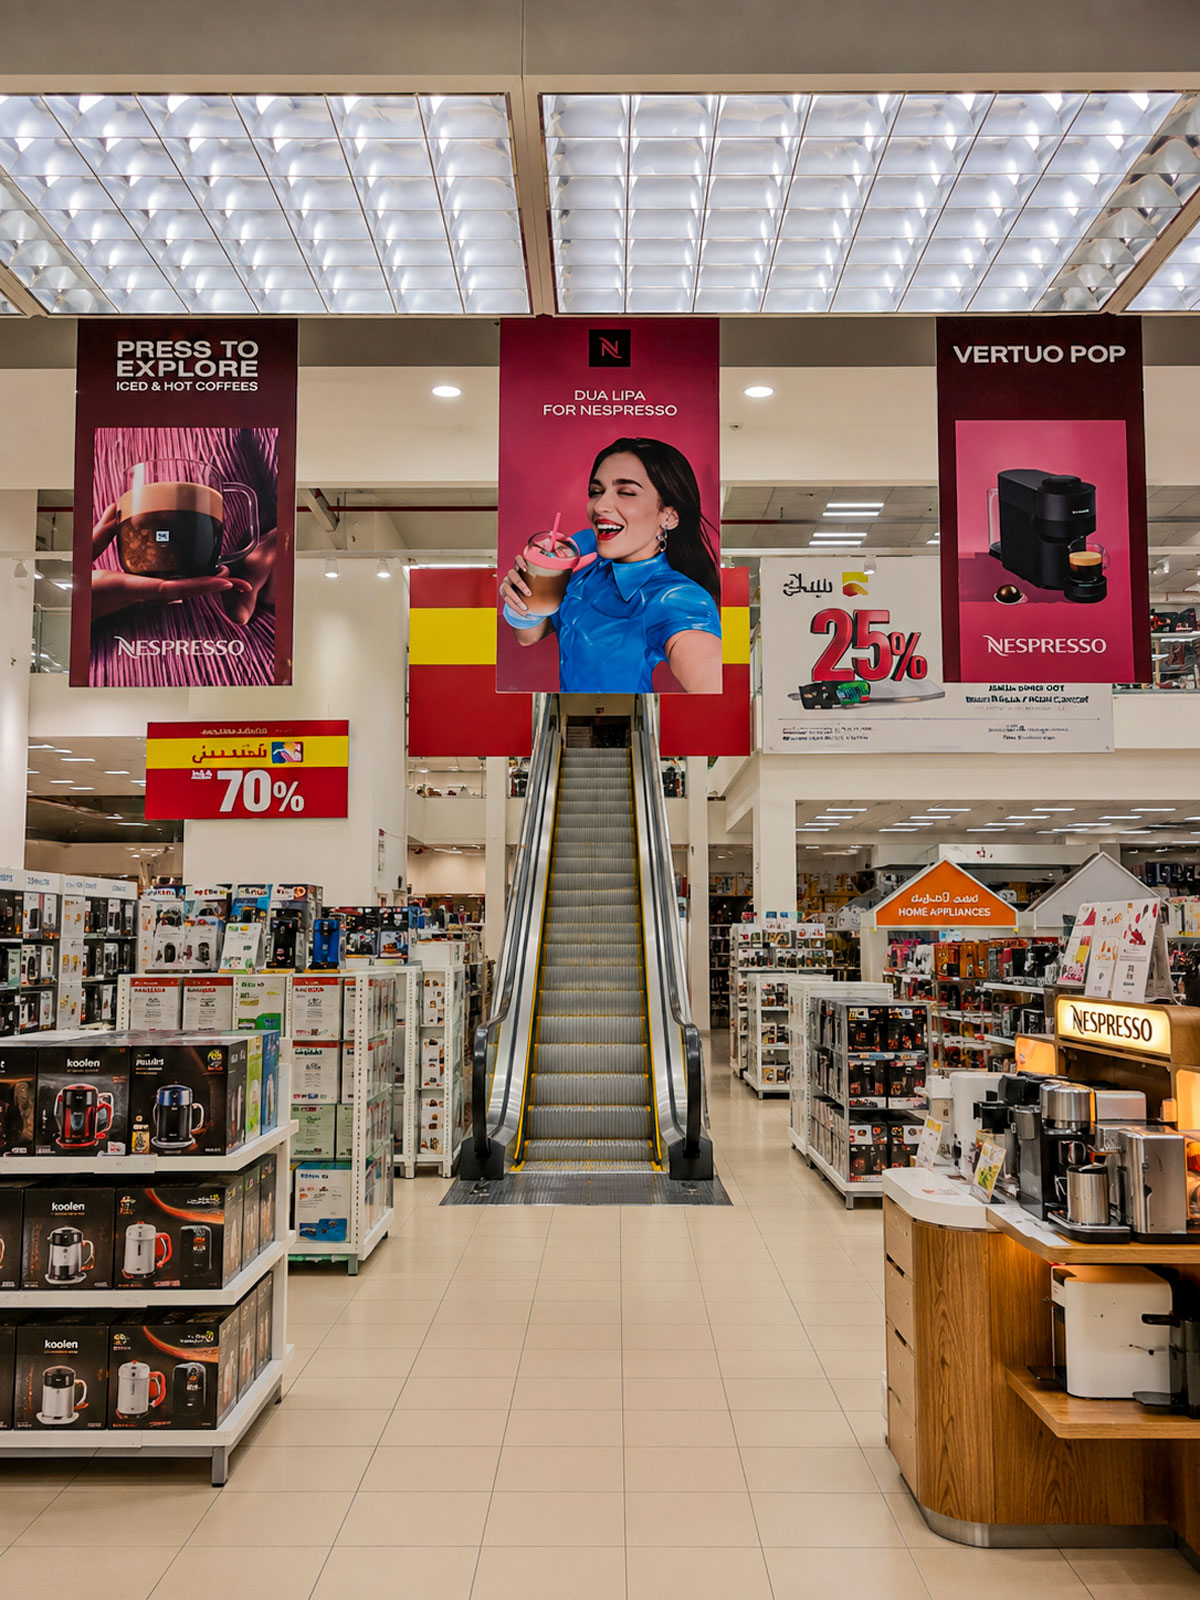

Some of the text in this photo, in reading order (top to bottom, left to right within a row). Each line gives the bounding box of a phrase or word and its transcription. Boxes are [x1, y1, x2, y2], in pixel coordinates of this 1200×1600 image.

[116, 340, 260, 358] PRESS TO
[953, 345, 1127, 364] VERTUO POP
[116, 360, 259, 377] EXPLORE
[116, 381, 259, 391] ICED & HOT COFFEES
[574, 390, 646, 401] DUA LIPA
[543, 404, 678, 416] FOR NESPRESSO
[113, 635, 245, 659] NESPRESSO
[810, 608, 928, 682] 25%
[982, 634, 1107, 657] NESPRESSO
[216, 769, 305, 812] 70%
[898, 907, 991, 917] HOME APPLIANCES
[1070, 1004, 1153, 1042] NESPRESSO
[66, 1058, 100, 1068] koolen
[51, 1201, 85, 1211] koolen
[44, 1339, 78, 1349] koolen
